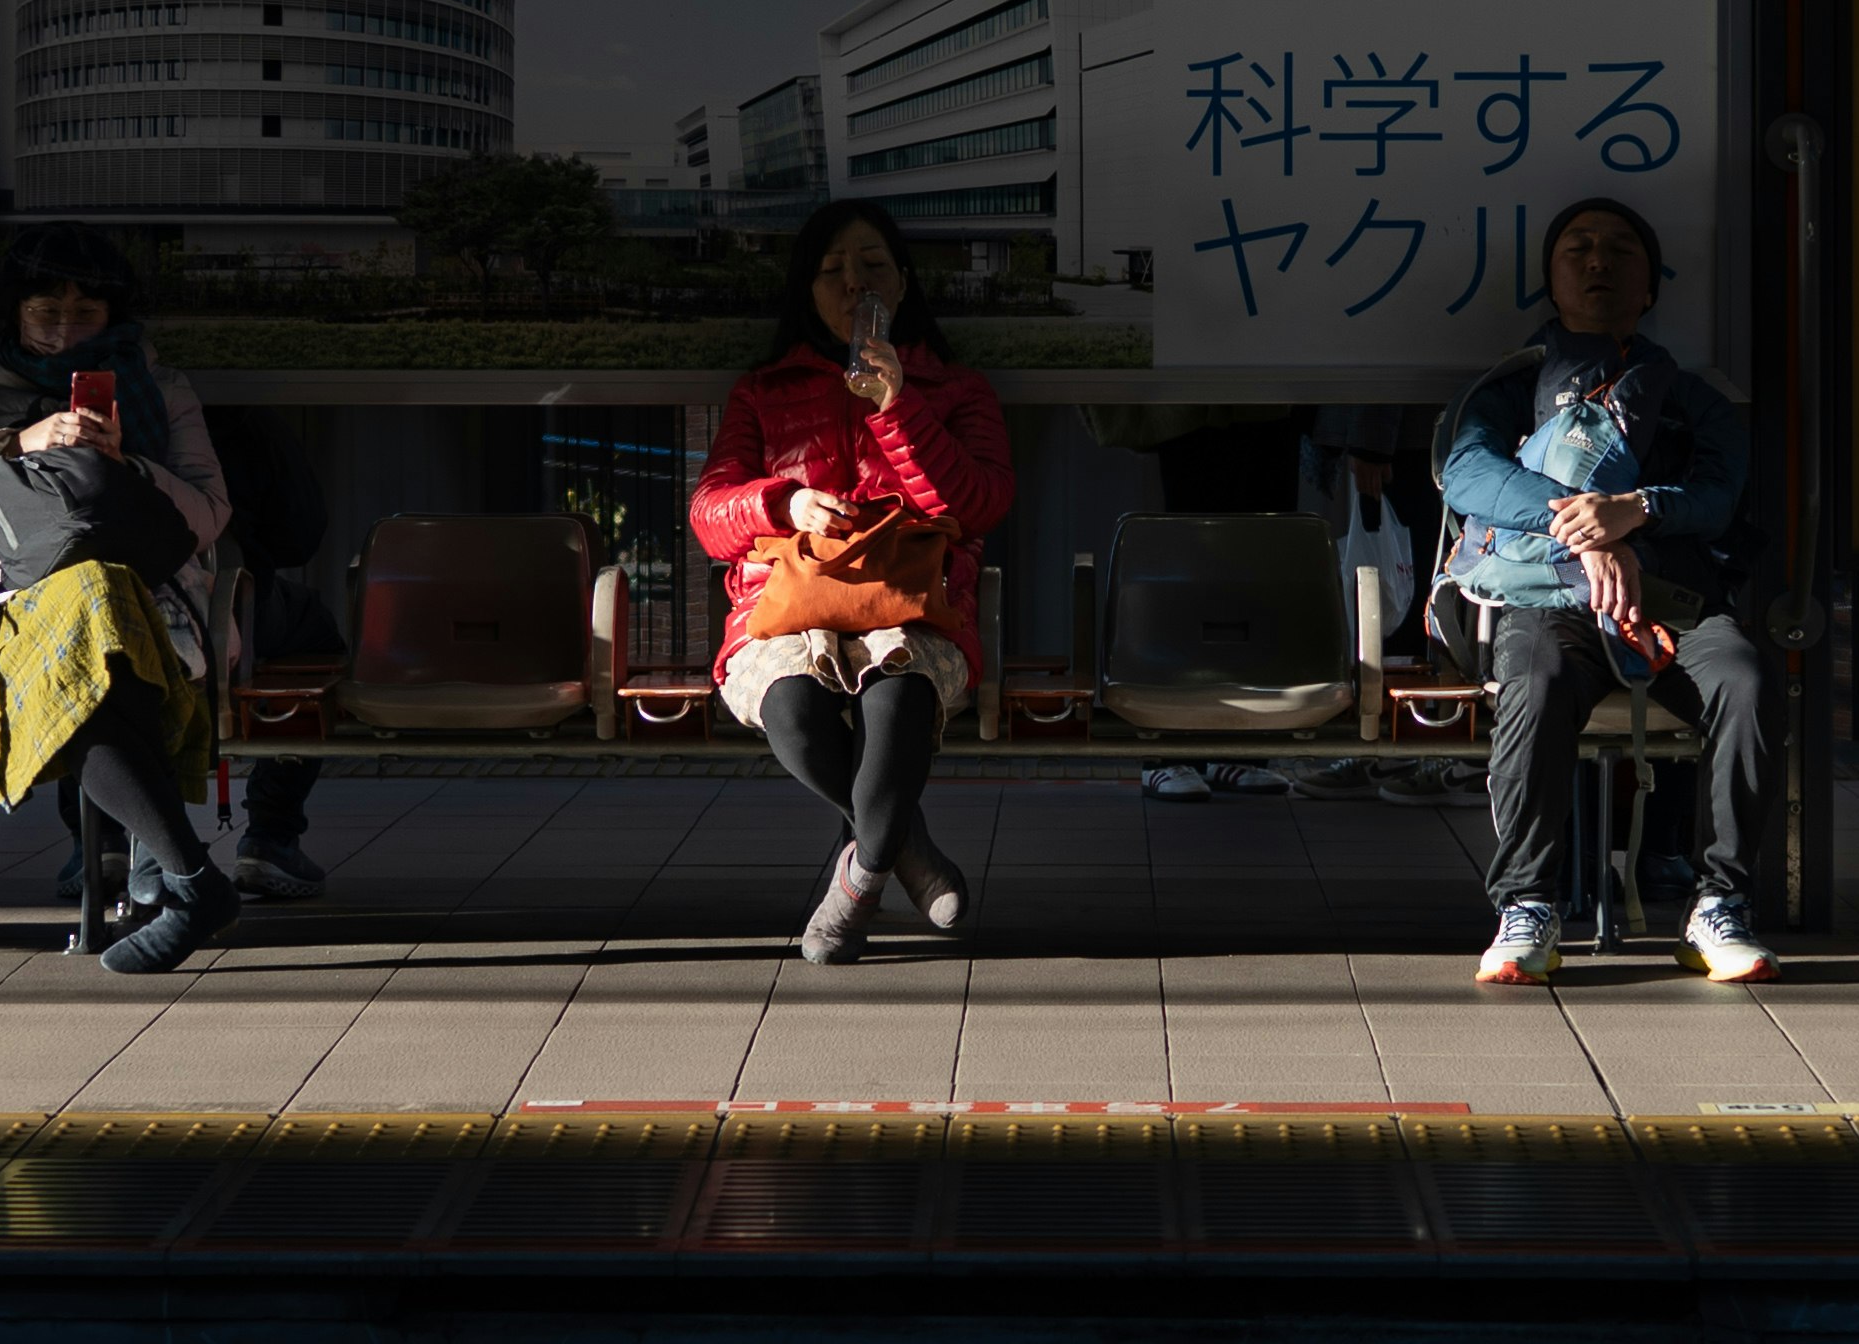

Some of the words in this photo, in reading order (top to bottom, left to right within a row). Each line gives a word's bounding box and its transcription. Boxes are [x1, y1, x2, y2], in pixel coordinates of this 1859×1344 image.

[1186, 52, 1680, 176] 科学する
[1194, 198, 1677, 317] ヤクル
